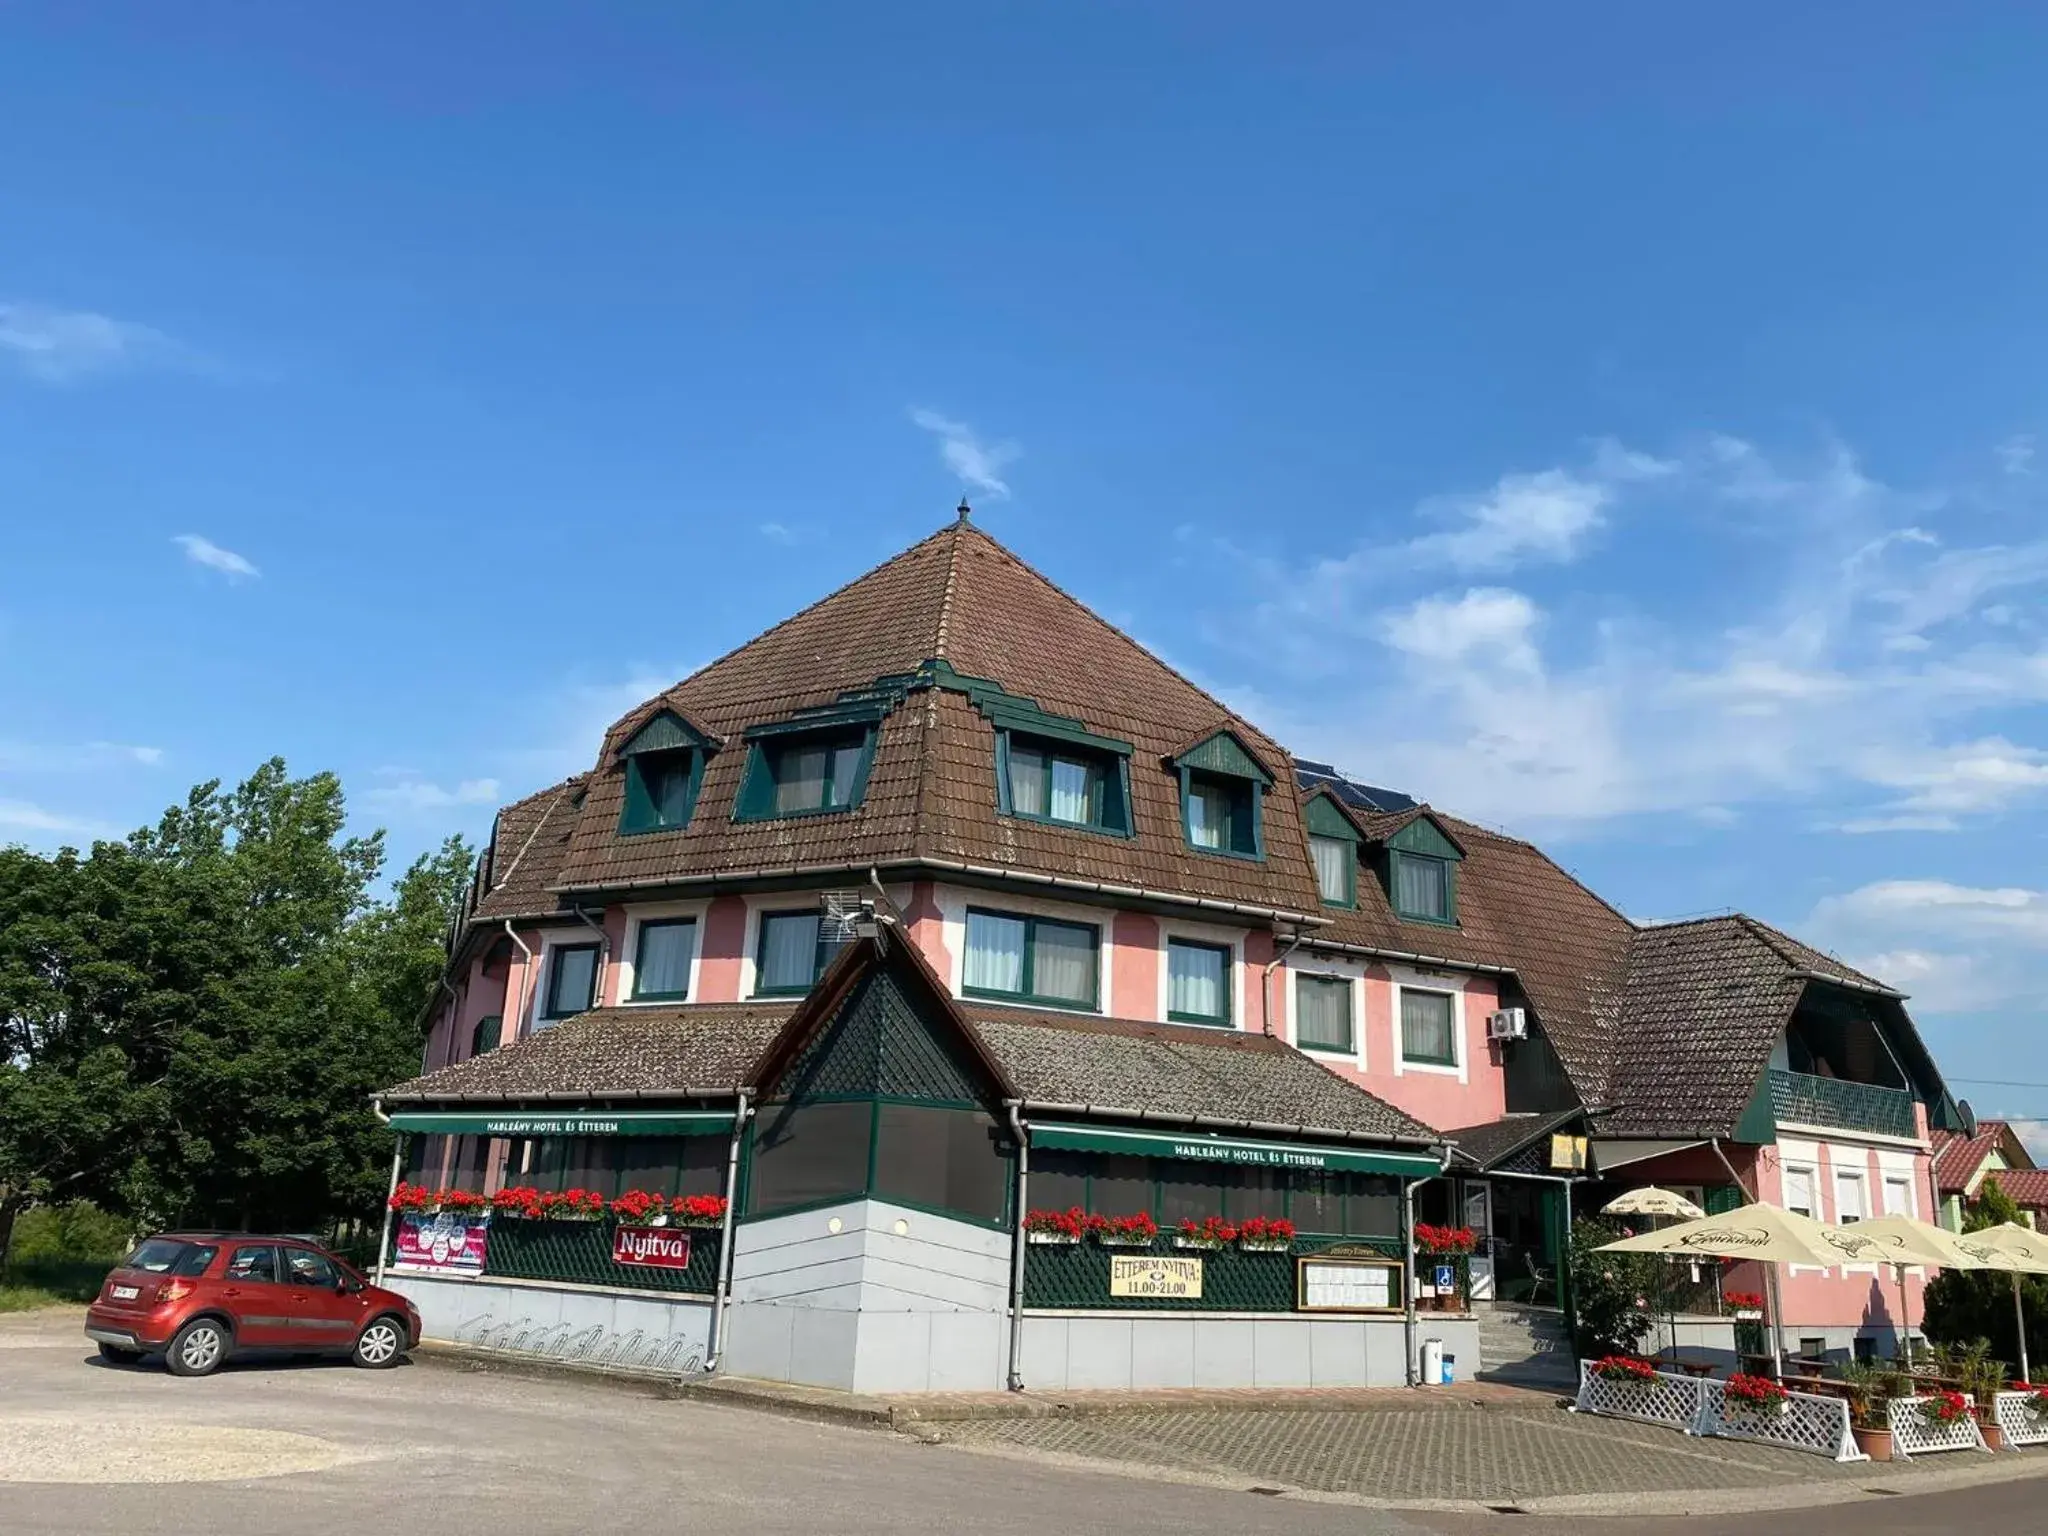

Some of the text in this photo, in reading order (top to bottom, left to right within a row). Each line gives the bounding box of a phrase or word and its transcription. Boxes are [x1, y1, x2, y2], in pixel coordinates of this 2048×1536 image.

[487, 1120, 618, 1132] HABLEÁNY HOTEL ÉS ÉTTEREM
[1174, 1145, 1325, 1167] HABLEÁNY HOTEL ÉS ÉTTEREM
[619, 1231, 683, 1261] Nyitva
[1114, 1258, 1200, 1281] ÉTTEREM NYITVA:
[1128, 1281, 1187, 1295] 11.00-21.00
